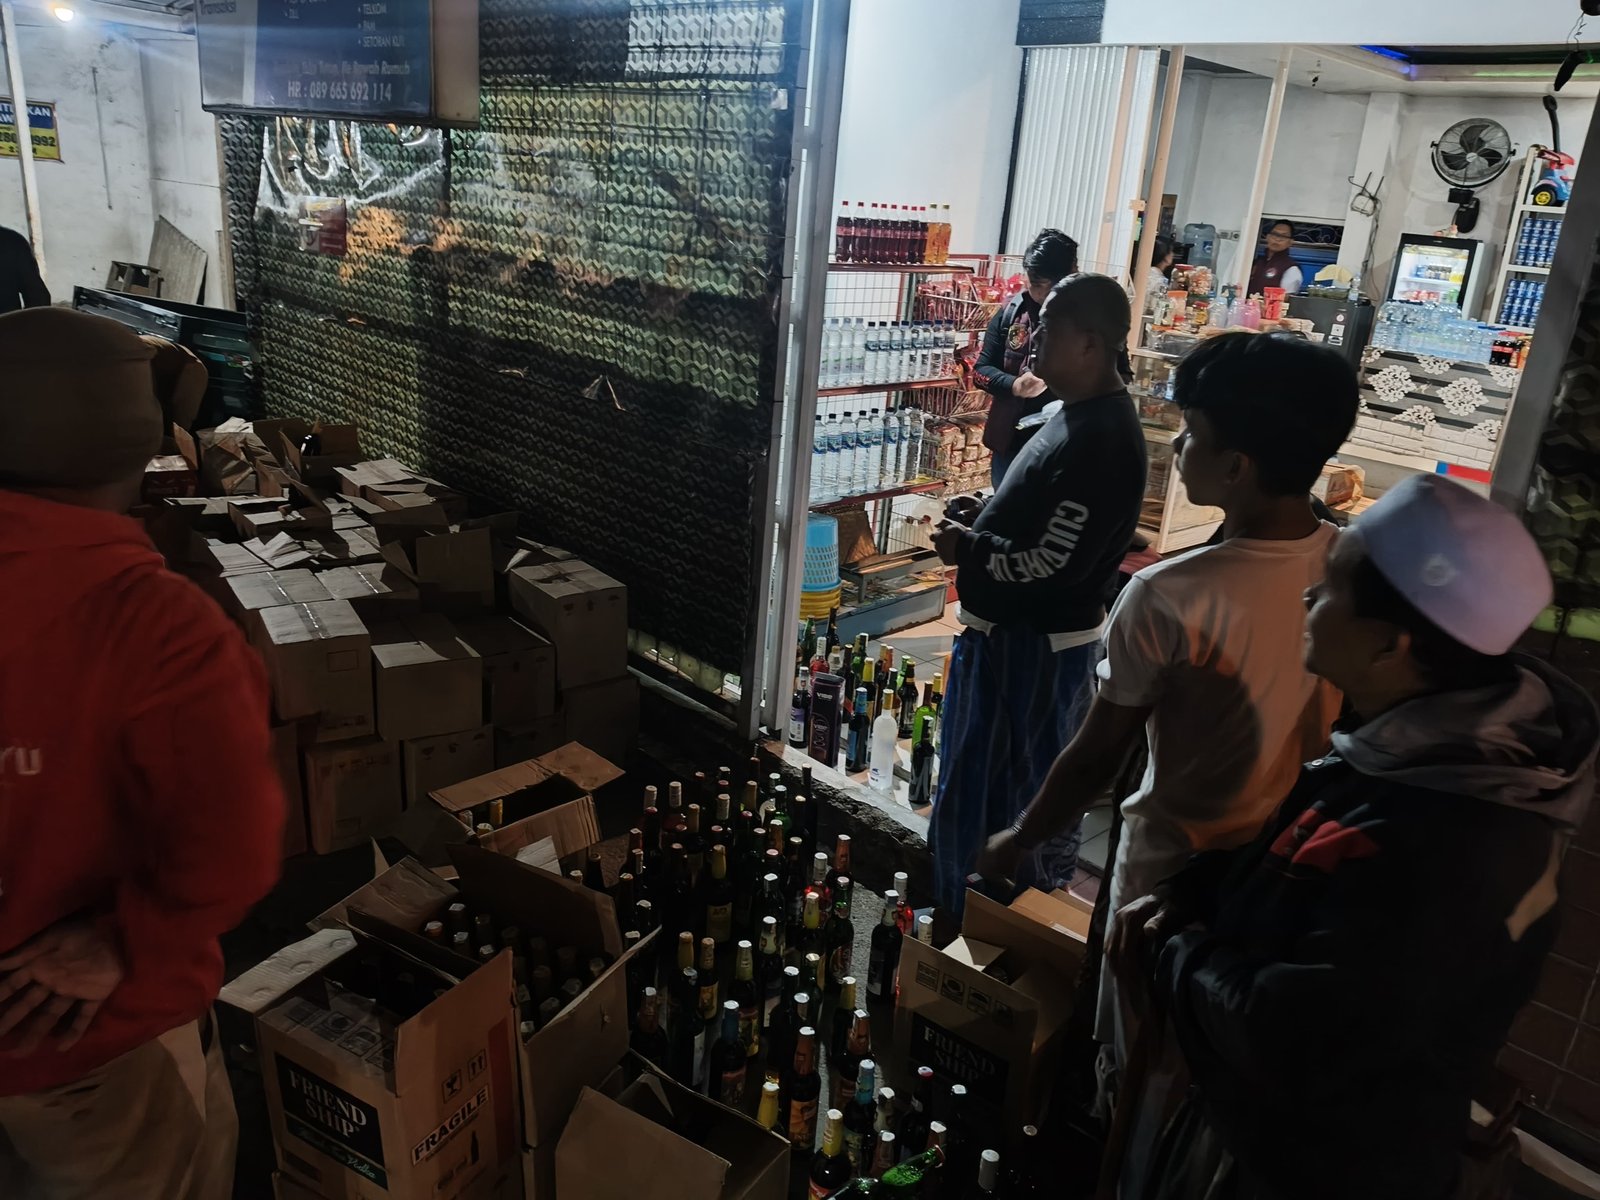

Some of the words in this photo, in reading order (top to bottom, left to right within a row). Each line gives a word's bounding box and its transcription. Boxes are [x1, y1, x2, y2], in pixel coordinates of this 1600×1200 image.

[309, 82, 328, 99] 089
[350, 82, 369, 101] 692
[372, 83, 392, 101] 114
[923, 1025, 997, 1076] FRIEND
[934, 1049, 980, 1083] SHIP
[289, 1070, 367, 1126] FRIEND
[304, 1097, 355, 1138] SHIP
[414, 1089, 488, 1162] FRAGILE
